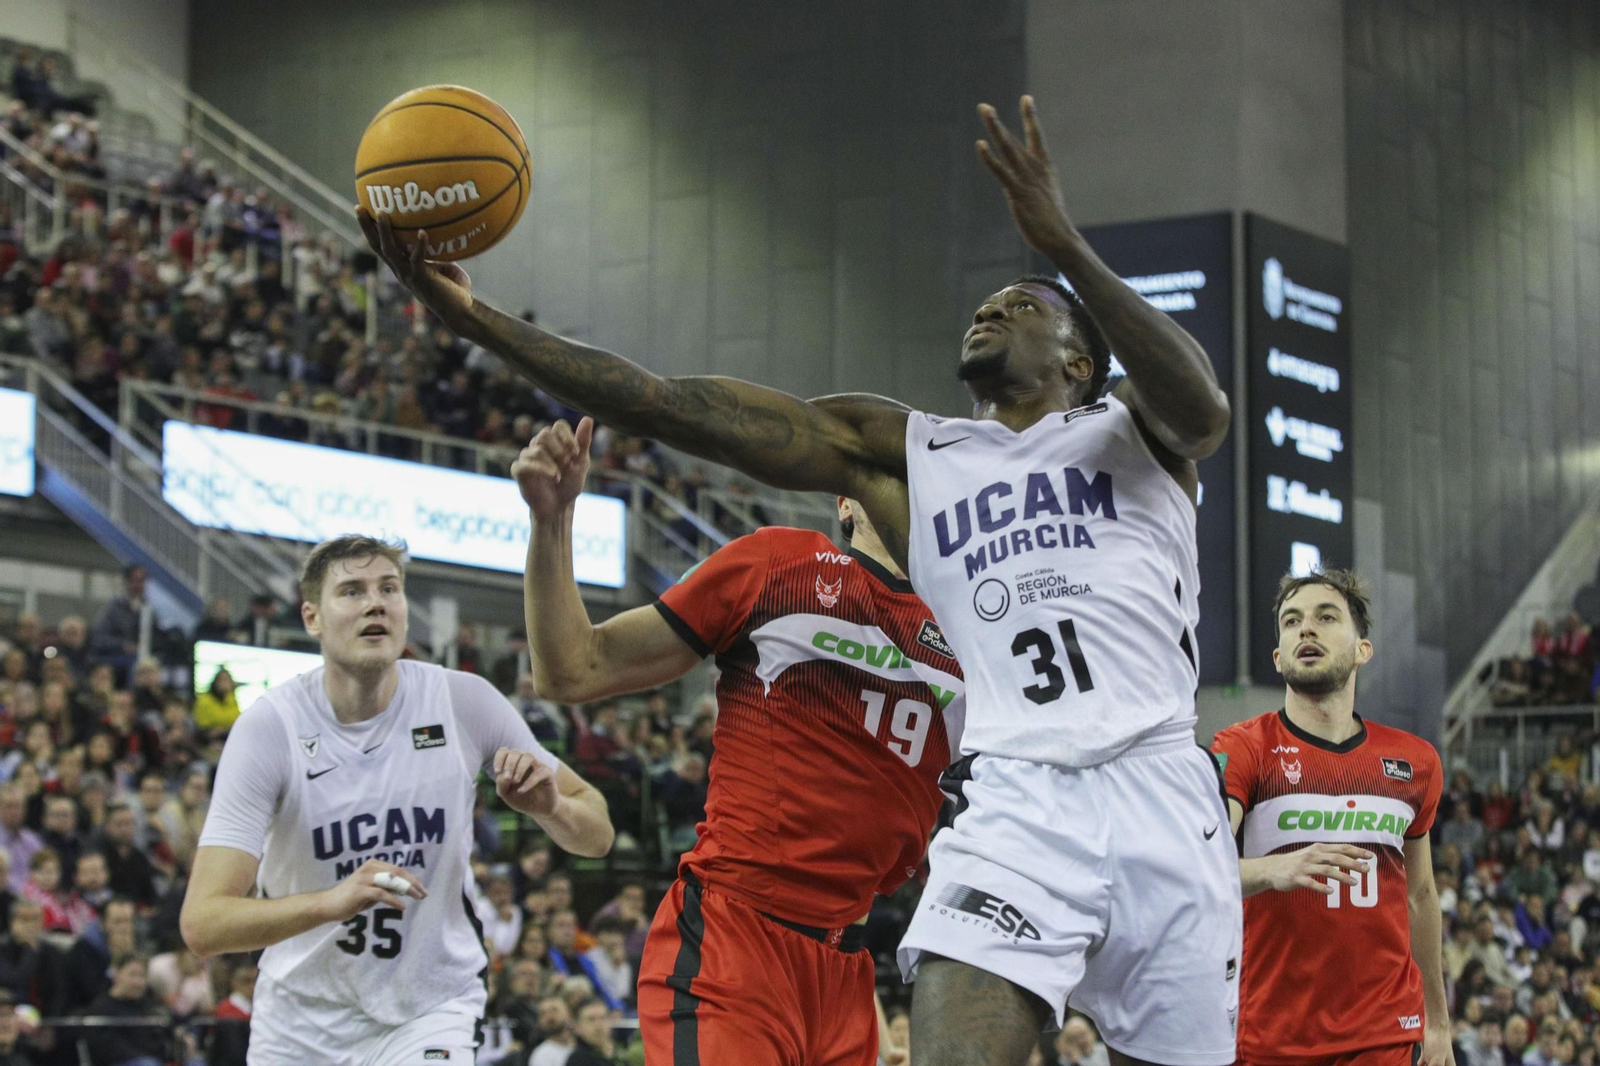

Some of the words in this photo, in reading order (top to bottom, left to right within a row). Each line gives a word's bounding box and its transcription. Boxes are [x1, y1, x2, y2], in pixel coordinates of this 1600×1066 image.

[366, 180, 480, 214] Wilson
[933, 467, 1118, 557] UCAM
[815, 551, 852, 565] vive
[964, 525, 1096, 581] MURCIA
[1015, 572, 1033, 580] Costa
[1016, 574, 1067, 593] REGIÓN
[1020, 591, 1038, 605] DE
[1040, 583, 1093, 600] MURCIA
[924, 626, 940, 640] liga
[1011, 619, 1095, 705] 31
[860, 689, 932, 768] 19
[313, 806, 445, 861] UCAM
[1277, 801, 1409, 837] COVIRAN
[336, 908, 403, 960] 35
[928, 904, 1019, 945] SOLUTIONS
[978, 895, 1042, 941] ESP
